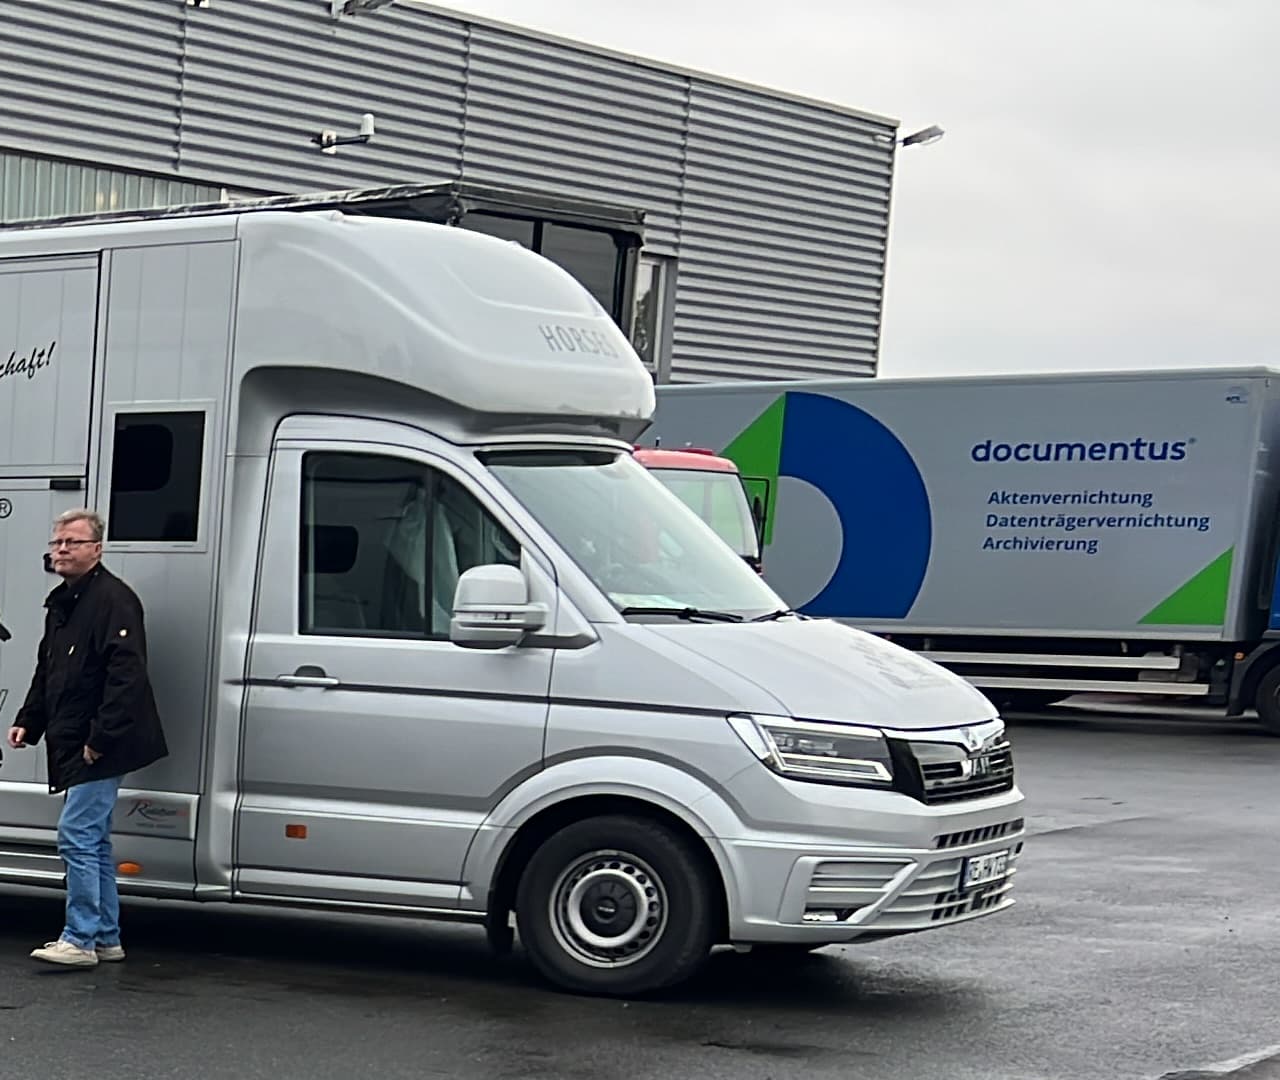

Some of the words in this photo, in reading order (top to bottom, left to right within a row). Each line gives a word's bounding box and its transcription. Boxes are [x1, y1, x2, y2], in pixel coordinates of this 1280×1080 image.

[971, 437, 1187, 463] documentus
[987, 490, 1154, 508] Aktenvernichtung
[986, 513, 1211, 532] Datenträgervernichtung
[982, 536, 1099, 554] Archivierung
